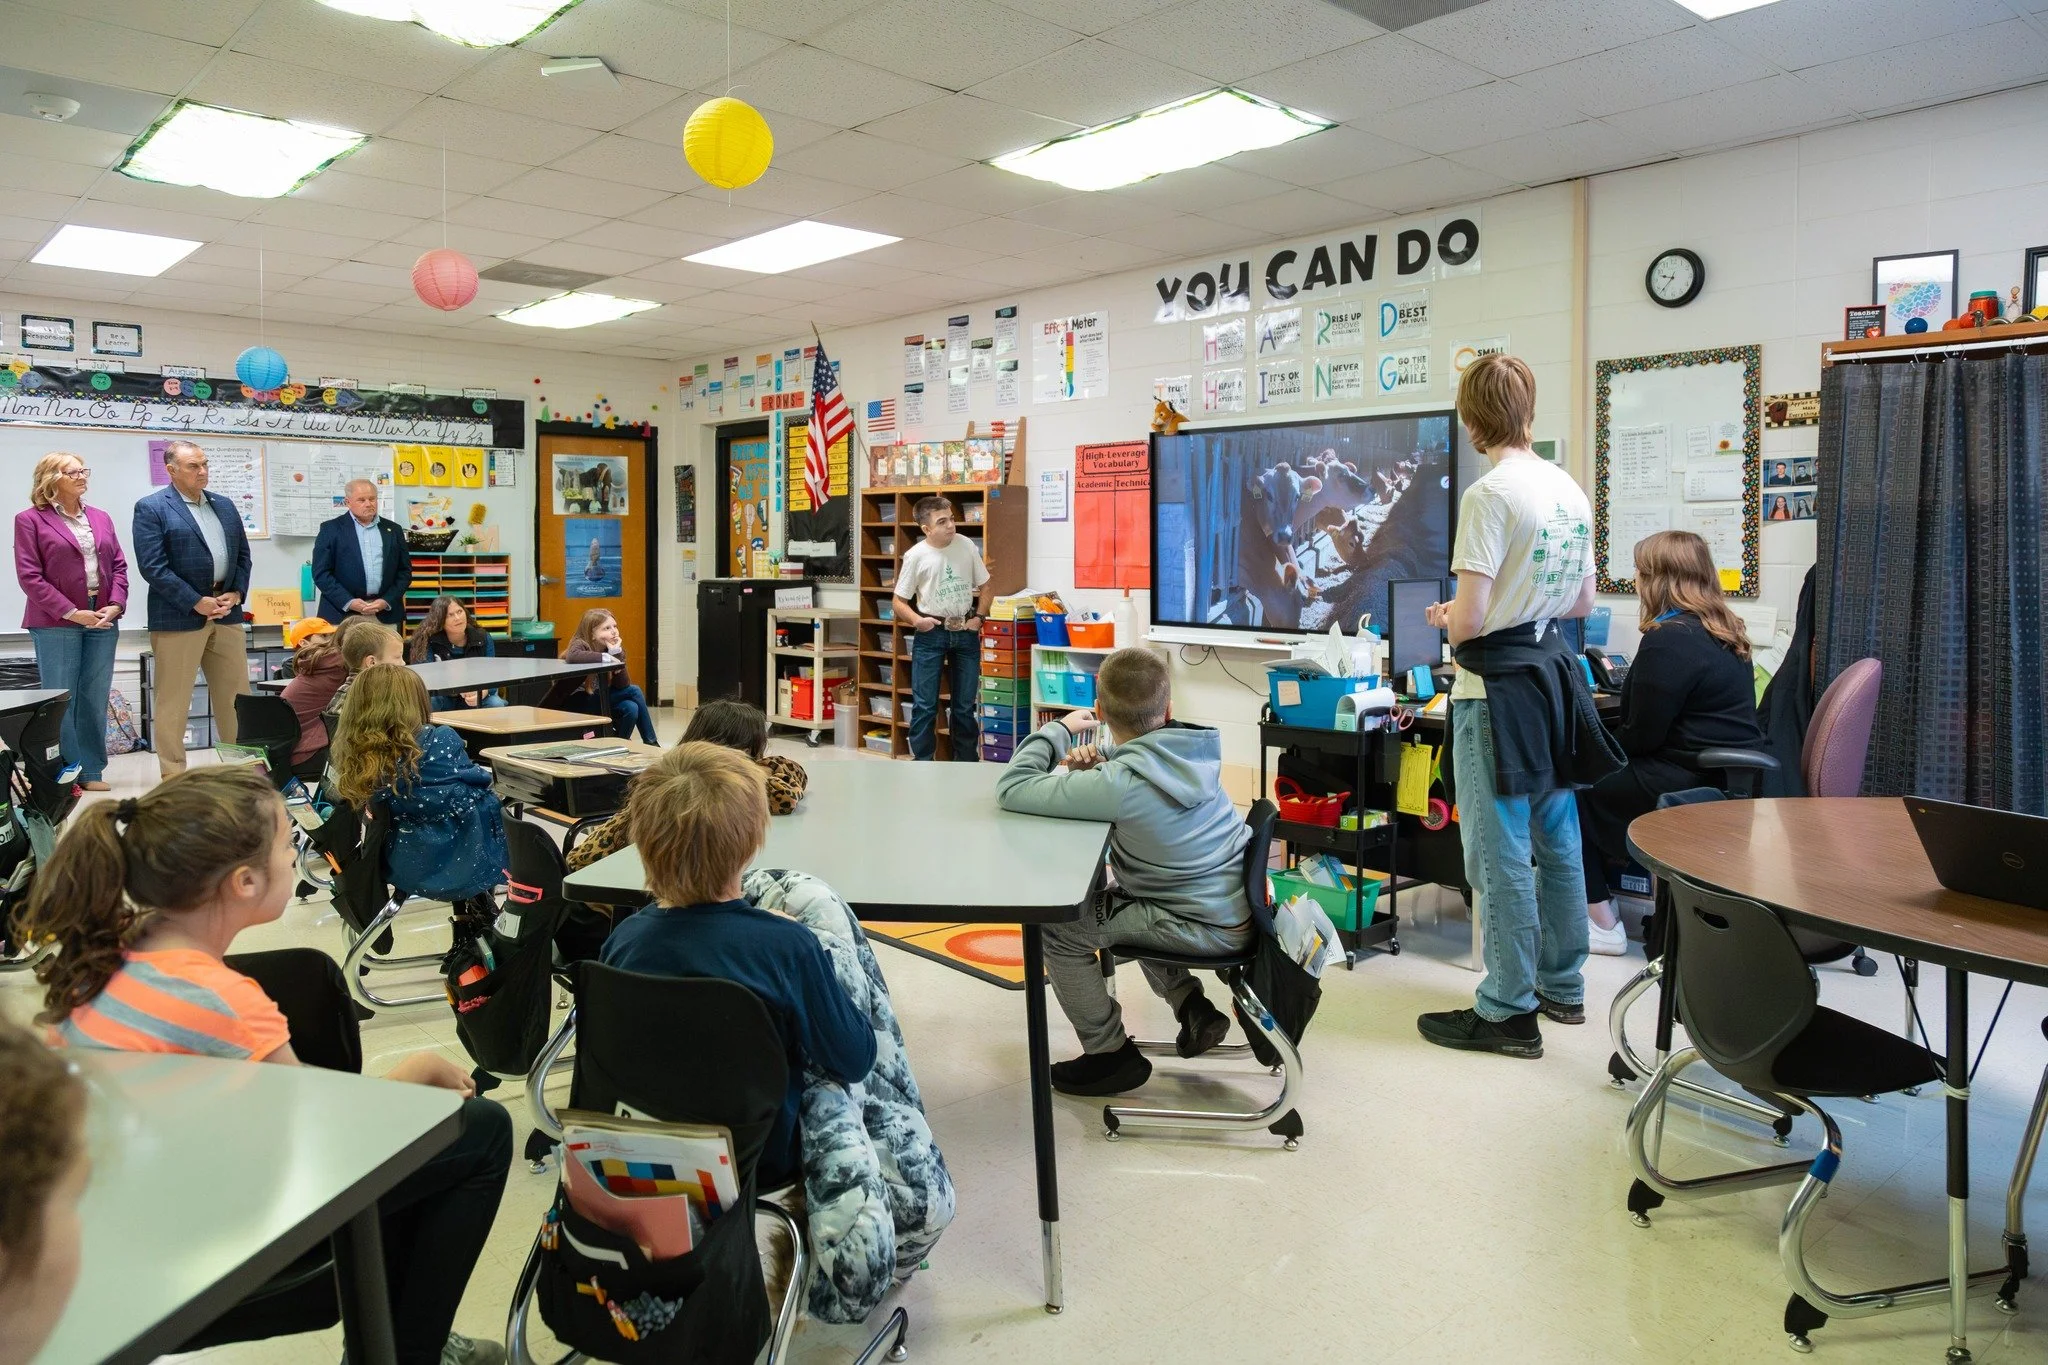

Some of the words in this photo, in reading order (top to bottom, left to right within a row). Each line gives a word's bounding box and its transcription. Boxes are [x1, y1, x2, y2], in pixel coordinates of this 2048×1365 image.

[1156, 261, 1249, 316] YOU
[1266, 234, 1378, 300] CAN
[1397, 219, 1480, 275] DO
[1399, 301, 1410, 309] do
[1411, 300, 1427, 309] your
[1332, 314, 1348, 323] RISE
[1351, 312, 1362, 321] UP
[1399, 306, 1427, 319] BEST
[1071, 316, 1098, 330] Meter
[1381, 303, 1398, 337] D
[1317, 312, 1332, 345] R
[1332, 321, 1360, 331] above
[1398, 358, 1410, 366] GO
[1412, 355, 1427, 364] THE
[92, 362, 110, 371] July
[1332, 363, 1359, 373] NEVER
[1398, 364, 1427, 374] EXTRA
[168, 368, 199, 378] August
[1269, 373, 1286, 382] IT'S
[1288, 371, 1300, 380] OK
[1380, 356, 1398, 391] G
[1316, 362, 1332, 397] N
[1397, 373, 1427, 386] MILE
[1167, 383, 1188, 393] trust
[1267, 387, 1301, 397] MISTAKES
[89, 399, 120, 420] Oo
[130, 400, 153, 429] Pp
[202, 404, 225, 426] Rr
[368, 418, 404, 435] Ww
[405, 420, 431, 437] Xx
[435, 420, 461, 444] Yy
[1085, 449, 1146, 460] High-Leverage
[1093, 459, 1140, 469] Vocabulary
[1076, 480, 1113, 489] Academic
